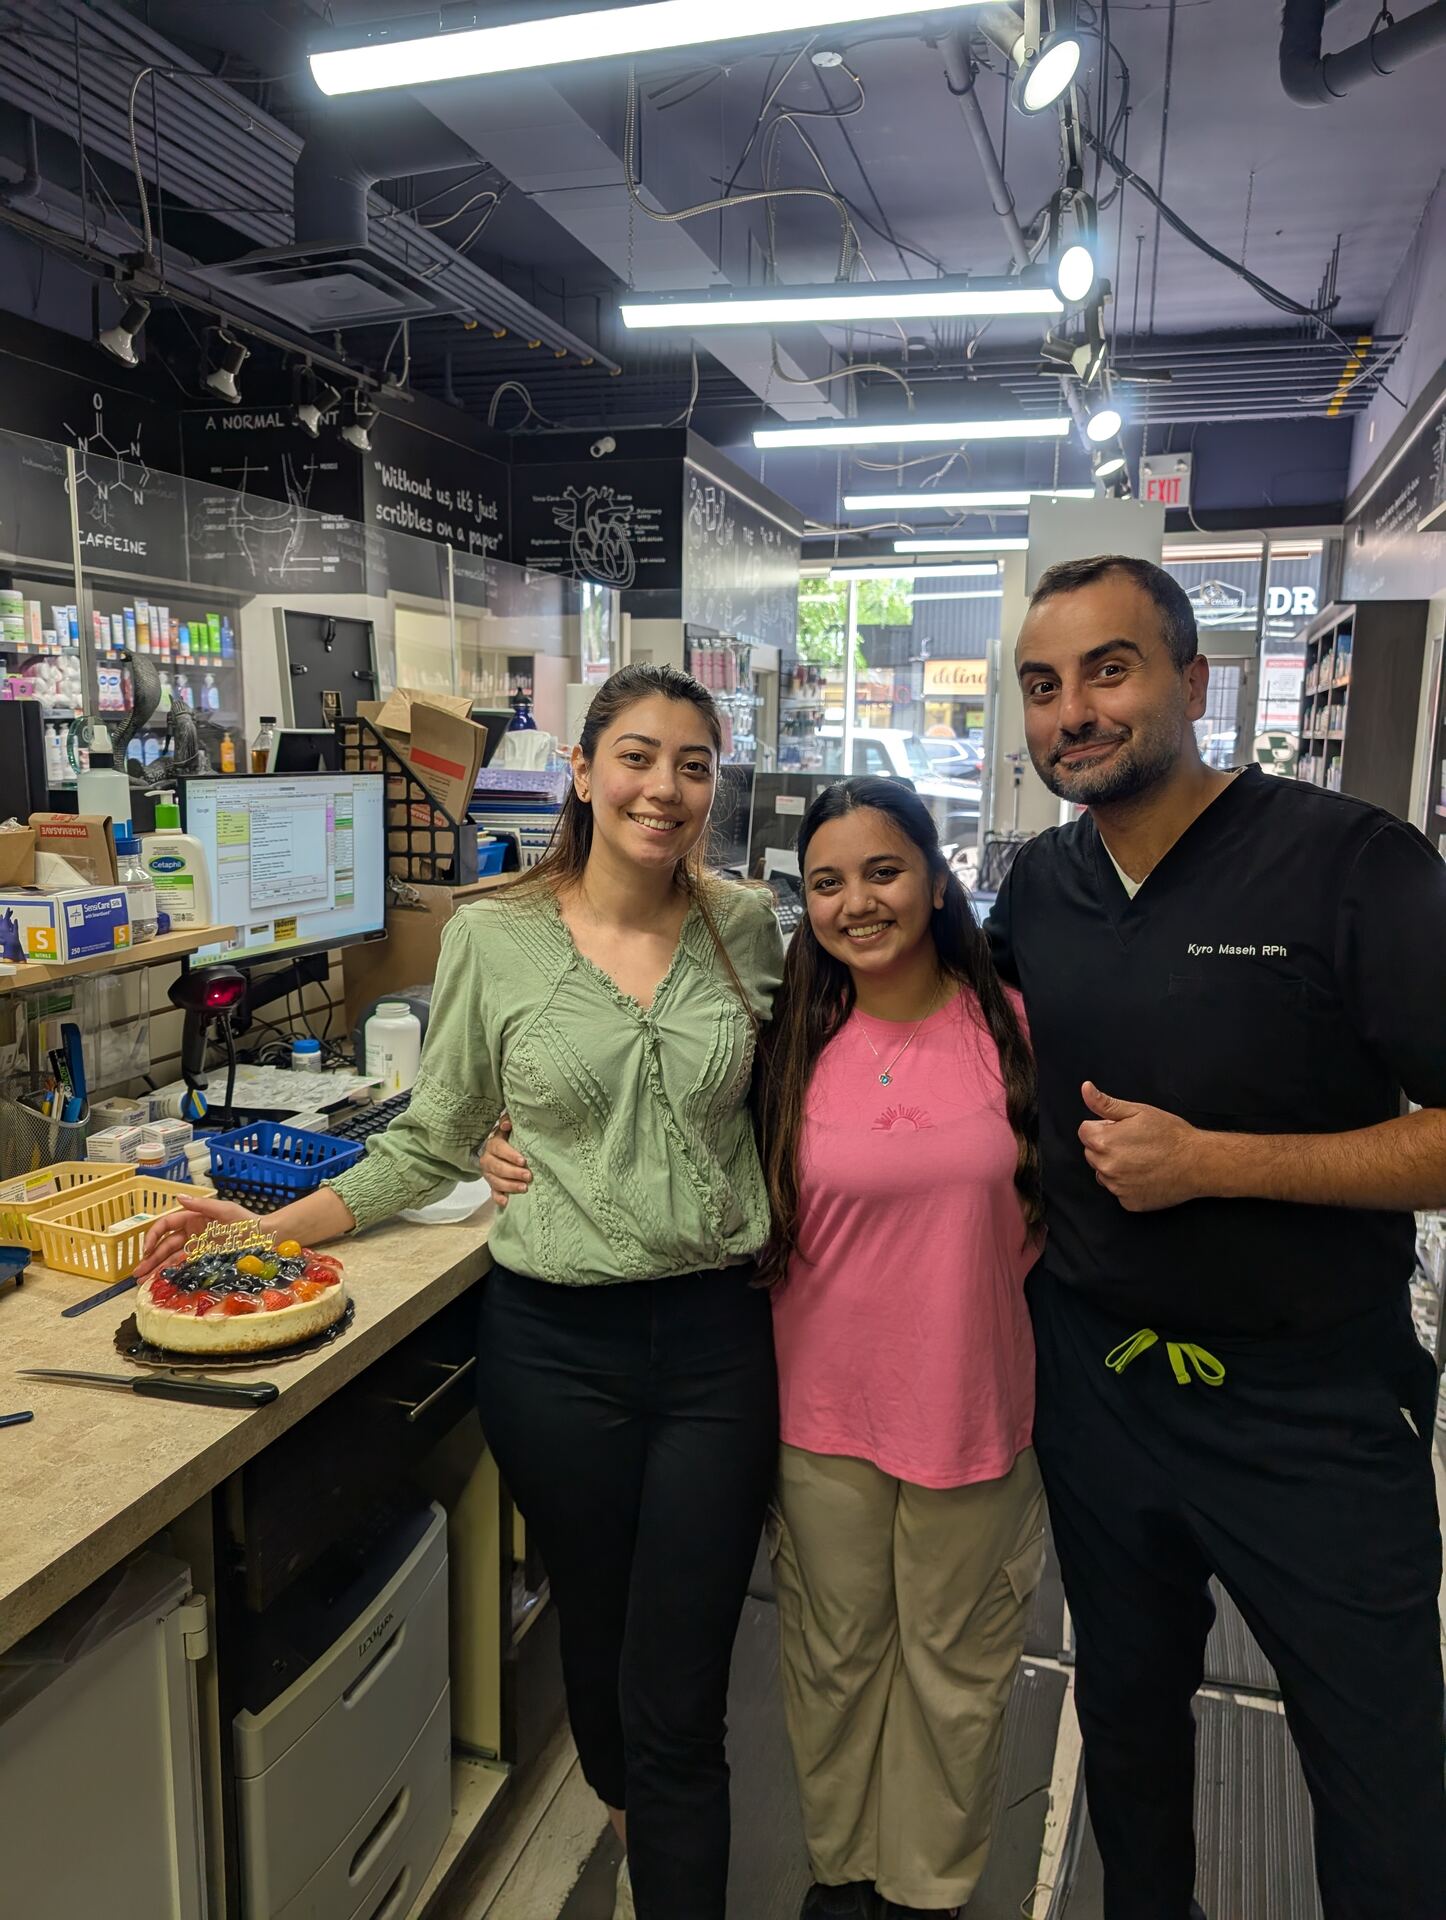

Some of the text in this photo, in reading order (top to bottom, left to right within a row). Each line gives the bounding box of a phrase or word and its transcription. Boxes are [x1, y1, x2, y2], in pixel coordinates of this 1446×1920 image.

[205, 416, 217, 430] A
[222, 412, 285, 430] NORMAL
[1146, 478, 1182, 504] EXIT
[436, 489, 453, 512] us,
[456, 489, 474, 513] it's
[474, 494, 499, 523] just
[375, 501, 433, 534] scribbles
[436, 522, 454, 538] on
[457, 527, 466, 542] a
[77, 529, 147, 556] CAFFEINE
[1266, 586, 1318, 615] DR
[41, 826, 88, 837] PHARMASAVE
[151, 861, 182, 869] Cetaphil
[83, 902, 110, 912] SensiCare
[35, 929, 49, 950] S
[118, 927, 126, 942] S
[71, 947, 80, 955] 250
[1187, 943, 1287, 957] Kyro Maseh RPh
[204, 1218, 262, 1238] Happy
[183, 1230, 278, 1263] Birthday
